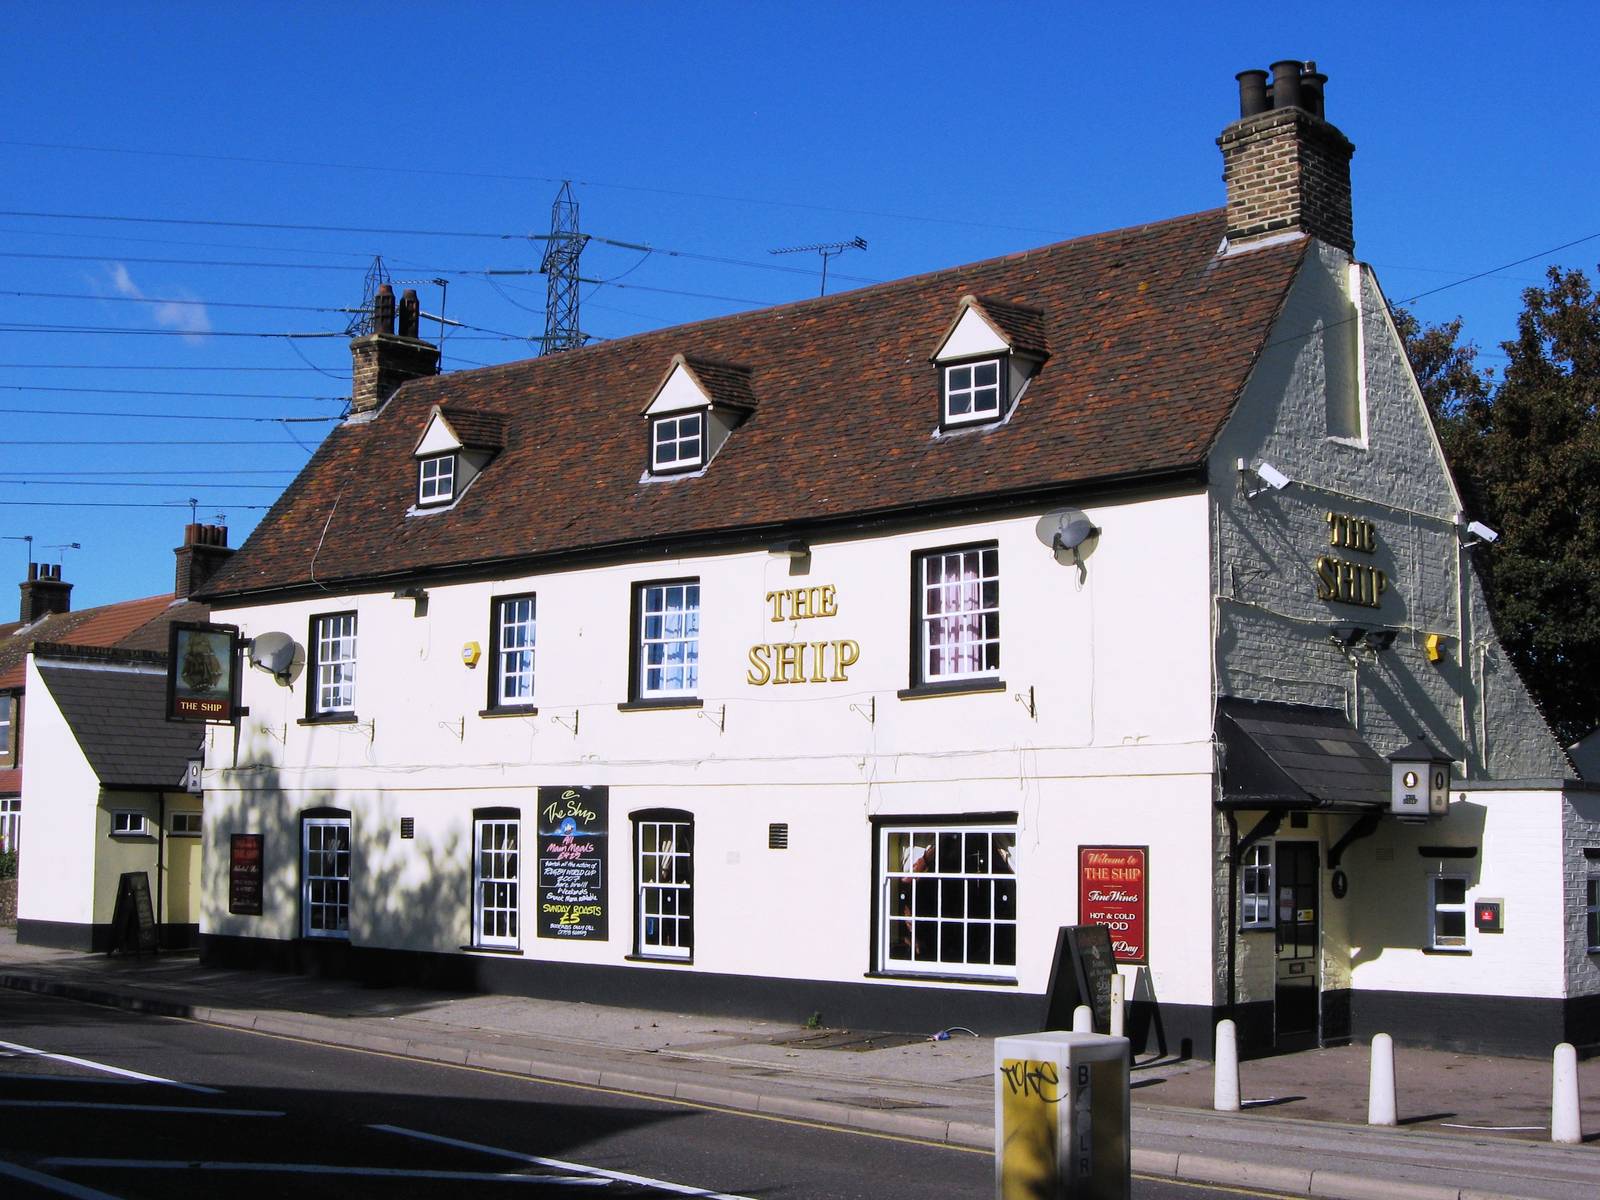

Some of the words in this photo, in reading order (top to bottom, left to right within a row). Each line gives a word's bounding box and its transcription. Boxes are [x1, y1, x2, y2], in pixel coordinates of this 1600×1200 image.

[1327, 512, 1377, 555] THE
[1317, 555, 1389, 609] SHIP
[766, 584, 838, 622] THE
[747, 640, 860, 687] SHIP
[180, 701, 198, 710] THE
[201, 703, 222, 712] SHIP
[543, 801, 566, 824] The
[567, 801, 596, 824] Ship
[568, 843, 594, 852] Meals
[1088, 853, 1125, 865] Welcome
[1127, 856, 1138, 864] to
[1084, 868, 1110, 880] THE
[1111, 868, 1142, 880] SHIP
[1088, 891, 1109, 902] Fine
[1110, 891, 1138, 902] Wines
[543, 904, 570, 913] SUNDAY
[573, 905, 602, 916] ROASTS
[560, 912, 580, 925] £5
[1117, 941, 1138, 956] Day
